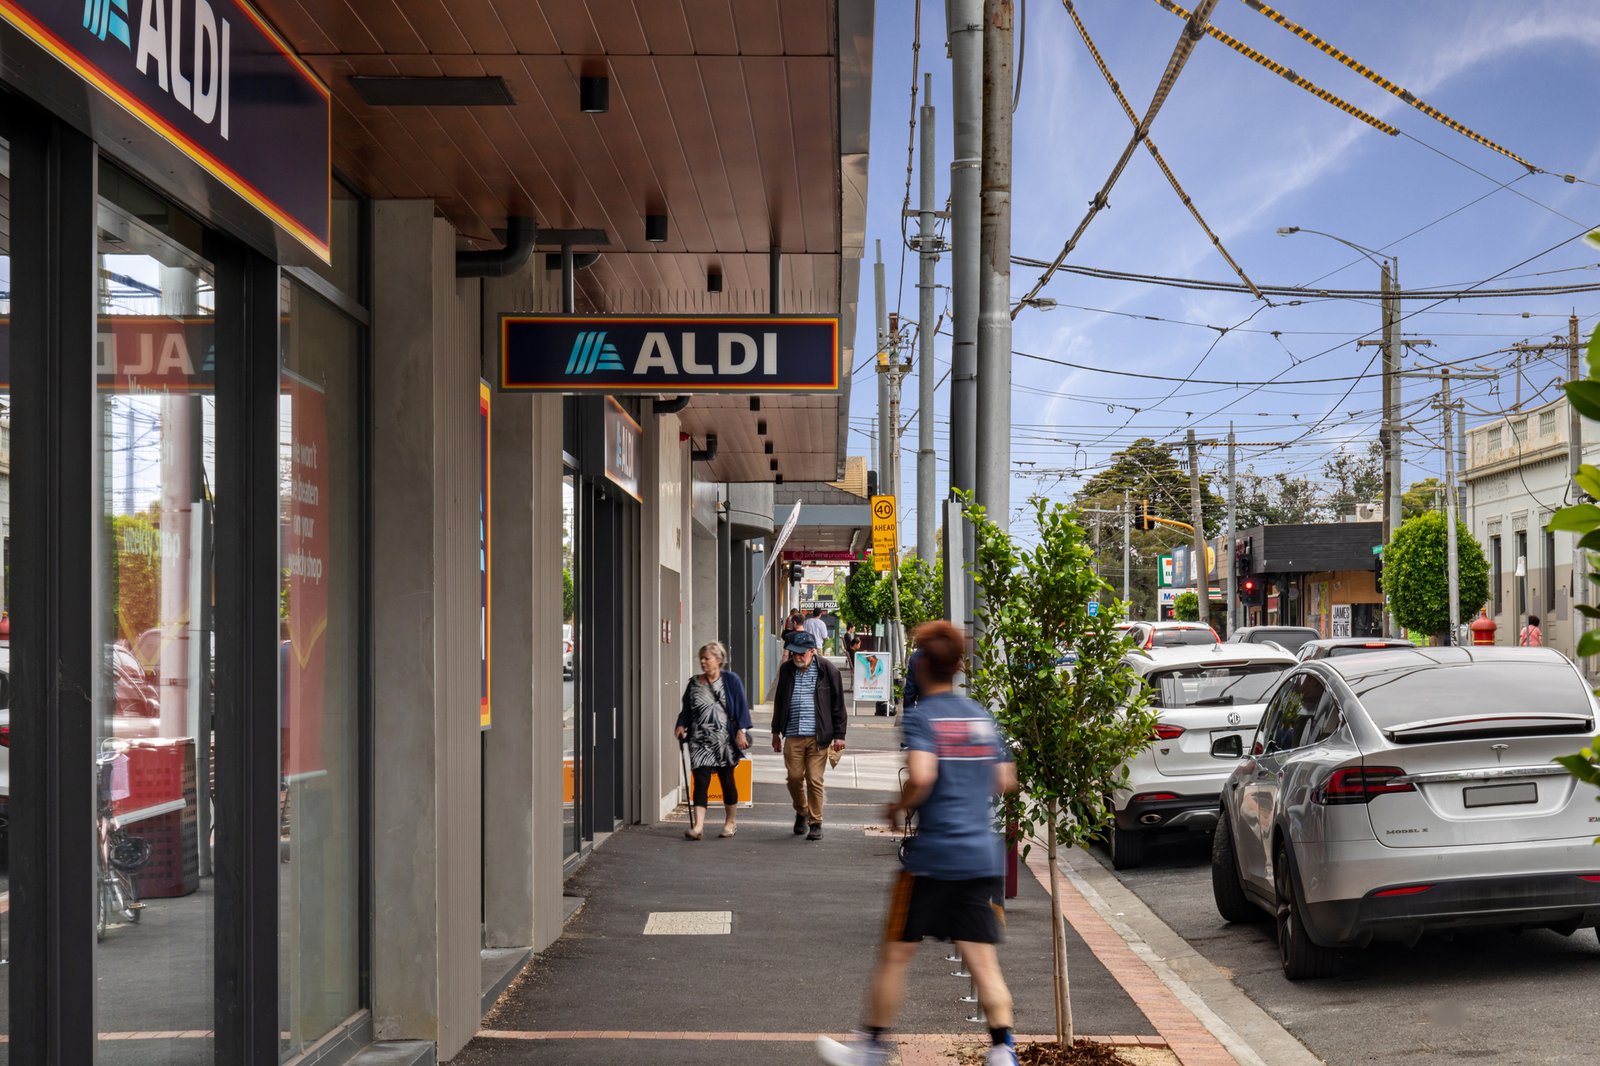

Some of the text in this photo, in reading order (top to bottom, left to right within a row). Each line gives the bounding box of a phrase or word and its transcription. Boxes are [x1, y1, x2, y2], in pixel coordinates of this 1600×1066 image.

[136, 0, 230, 141] ALDI
[632, 332, 777, 375] ALDI
[621, 425, 634, 481] ALDI
[876, 505, 891, 515] 40
[301, 516, 315, 544] your
[288, 547, 322, 586] weekly shop
[1333, 607, 1350, 619] JAMES
[1333, 624, 1350, 637] REYNE
[1228, 712, 1241, 726] MG
